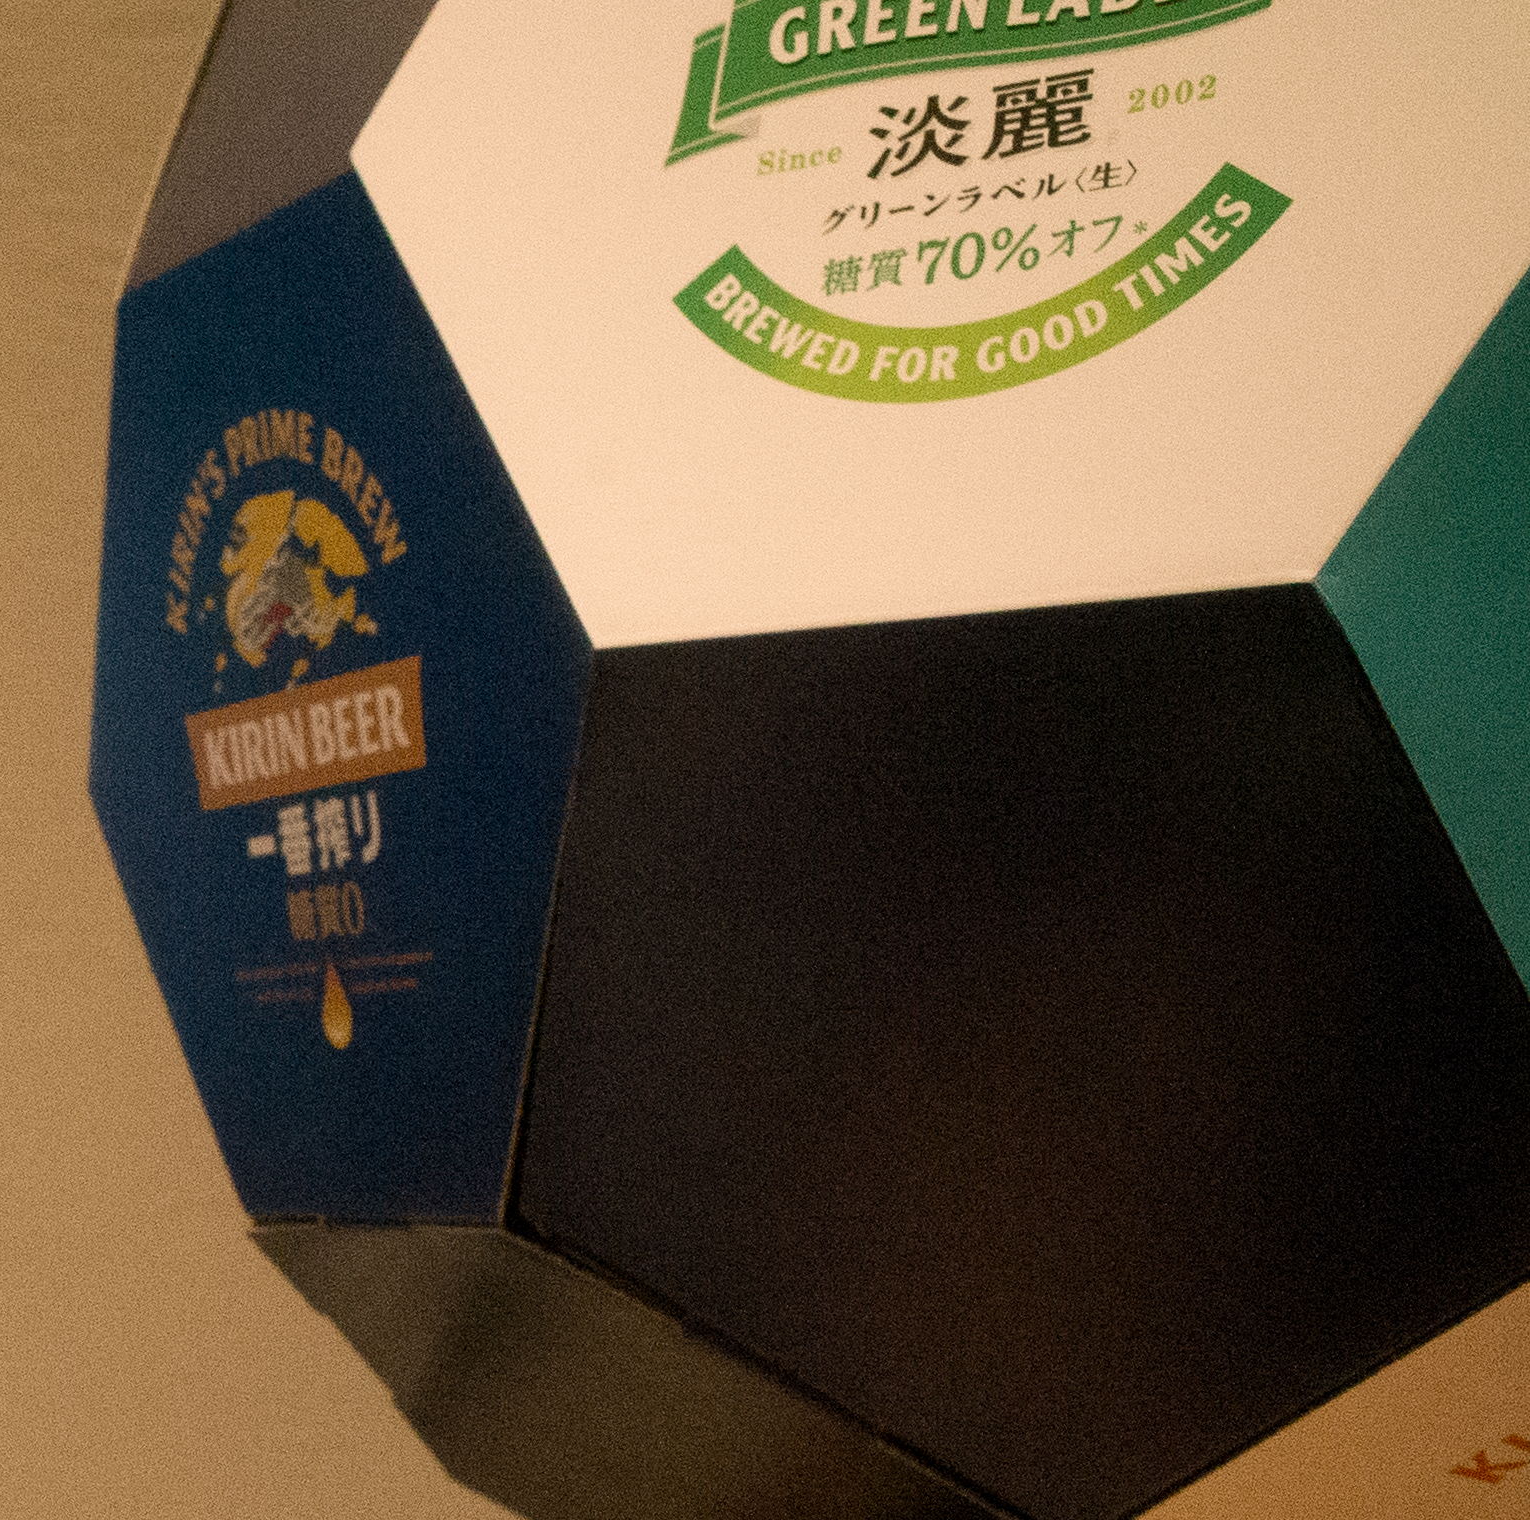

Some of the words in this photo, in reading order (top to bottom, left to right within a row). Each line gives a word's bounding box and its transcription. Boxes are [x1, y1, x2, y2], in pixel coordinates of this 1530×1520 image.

[756, 145, 843, 176] Since
[1127, 75, 1218, 115] 2002
[868, 68, 1095, 179] 淡麗
[704, 273, 860, 376] BREWED
[869, 344, 959, 383] FOR
[975, 298, 1108, 372] GOOD
[1114, 191, 1253, 309] TIMES
[166, 448, 226, 634] KIRIN'S
[223, 408, 314, 474] PRIME
[320, 426, 407, 563] BREW
[203, 708, 309, 790] KIRIN
[309, 683, 411, 766] BEER
